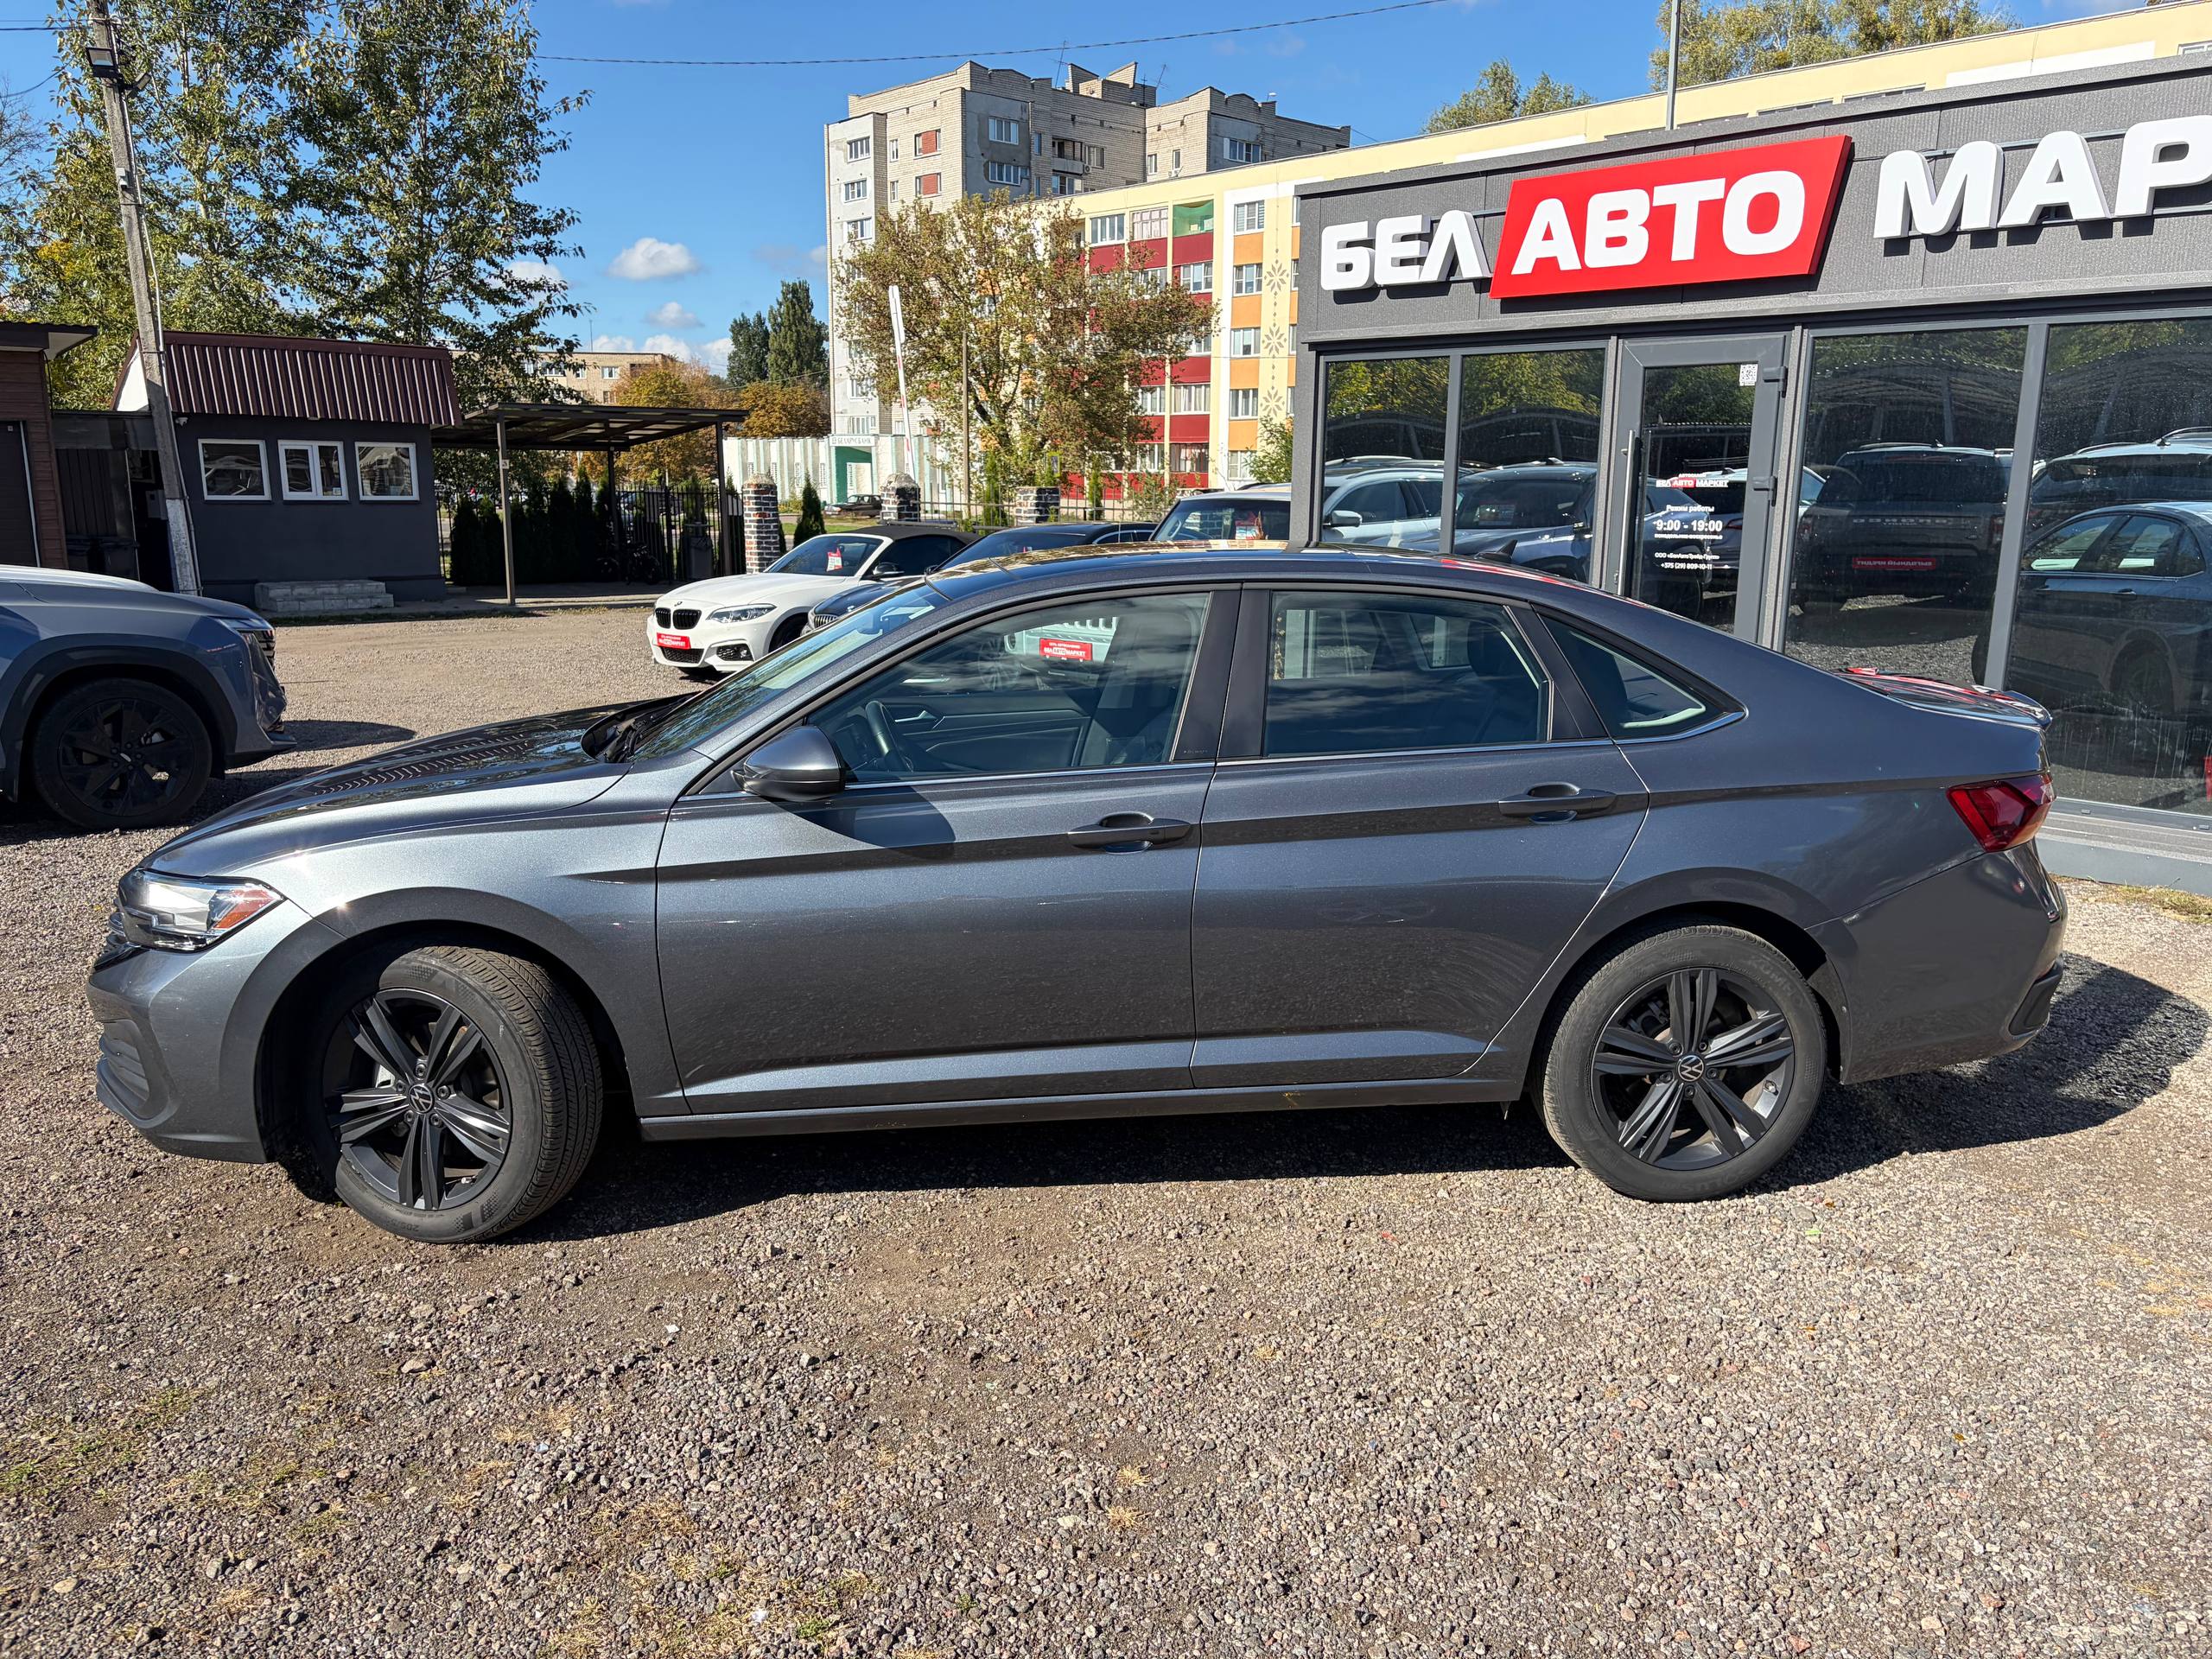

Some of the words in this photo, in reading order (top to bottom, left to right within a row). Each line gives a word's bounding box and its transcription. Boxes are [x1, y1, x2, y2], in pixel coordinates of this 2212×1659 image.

[1321, 210, 1491, 291] БЕЛ
[1512, 170, 1806, 276] АВТО
[1874, 114, 2212, 239] МАР
[1656, 519, 1681, 531] 9:00
[1691, 520, 1723, 531] 19:00
